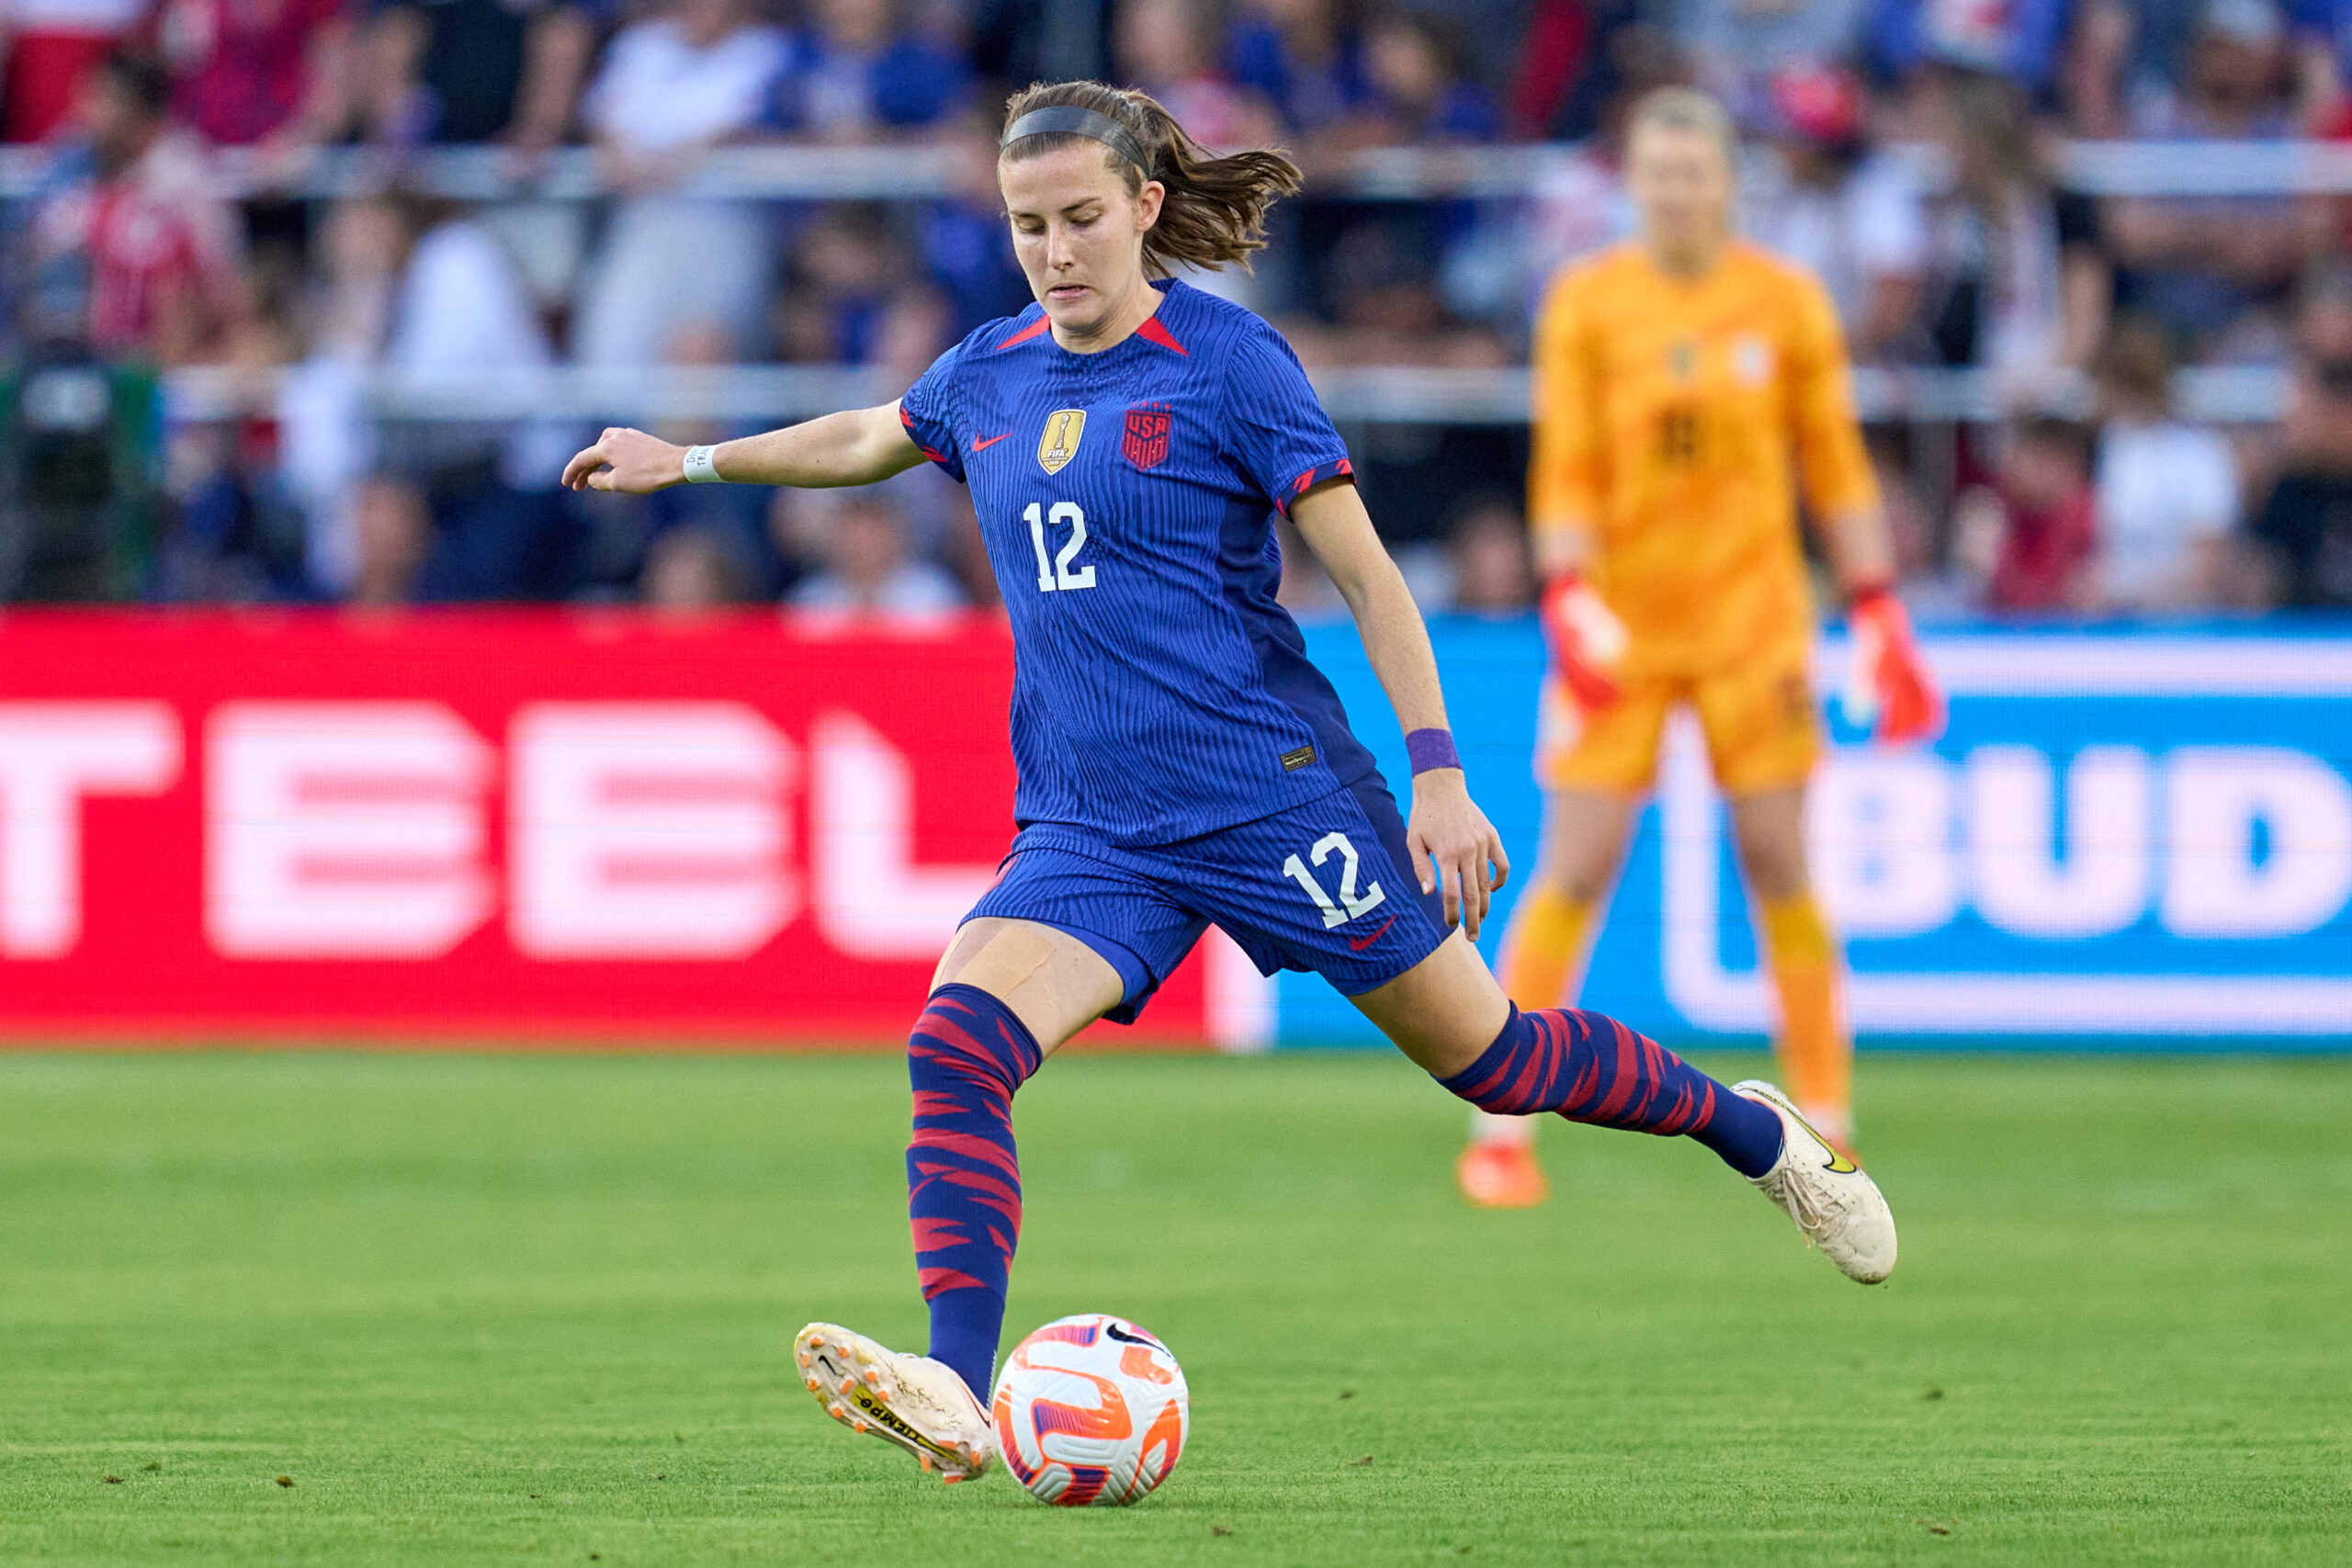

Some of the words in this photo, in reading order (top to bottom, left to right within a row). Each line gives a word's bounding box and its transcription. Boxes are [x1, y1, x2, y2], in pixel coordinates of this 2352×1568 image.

[1047, 448, 1067, 458] FIFA
[1128, 413, 1167, 438] USA
[1023, 502, 1096, 592] 12
[0, 700, 1007, 961] TEEL
[1803, 746, 2352, 939] BUD
[1283, 831, 1386, 930] 12
